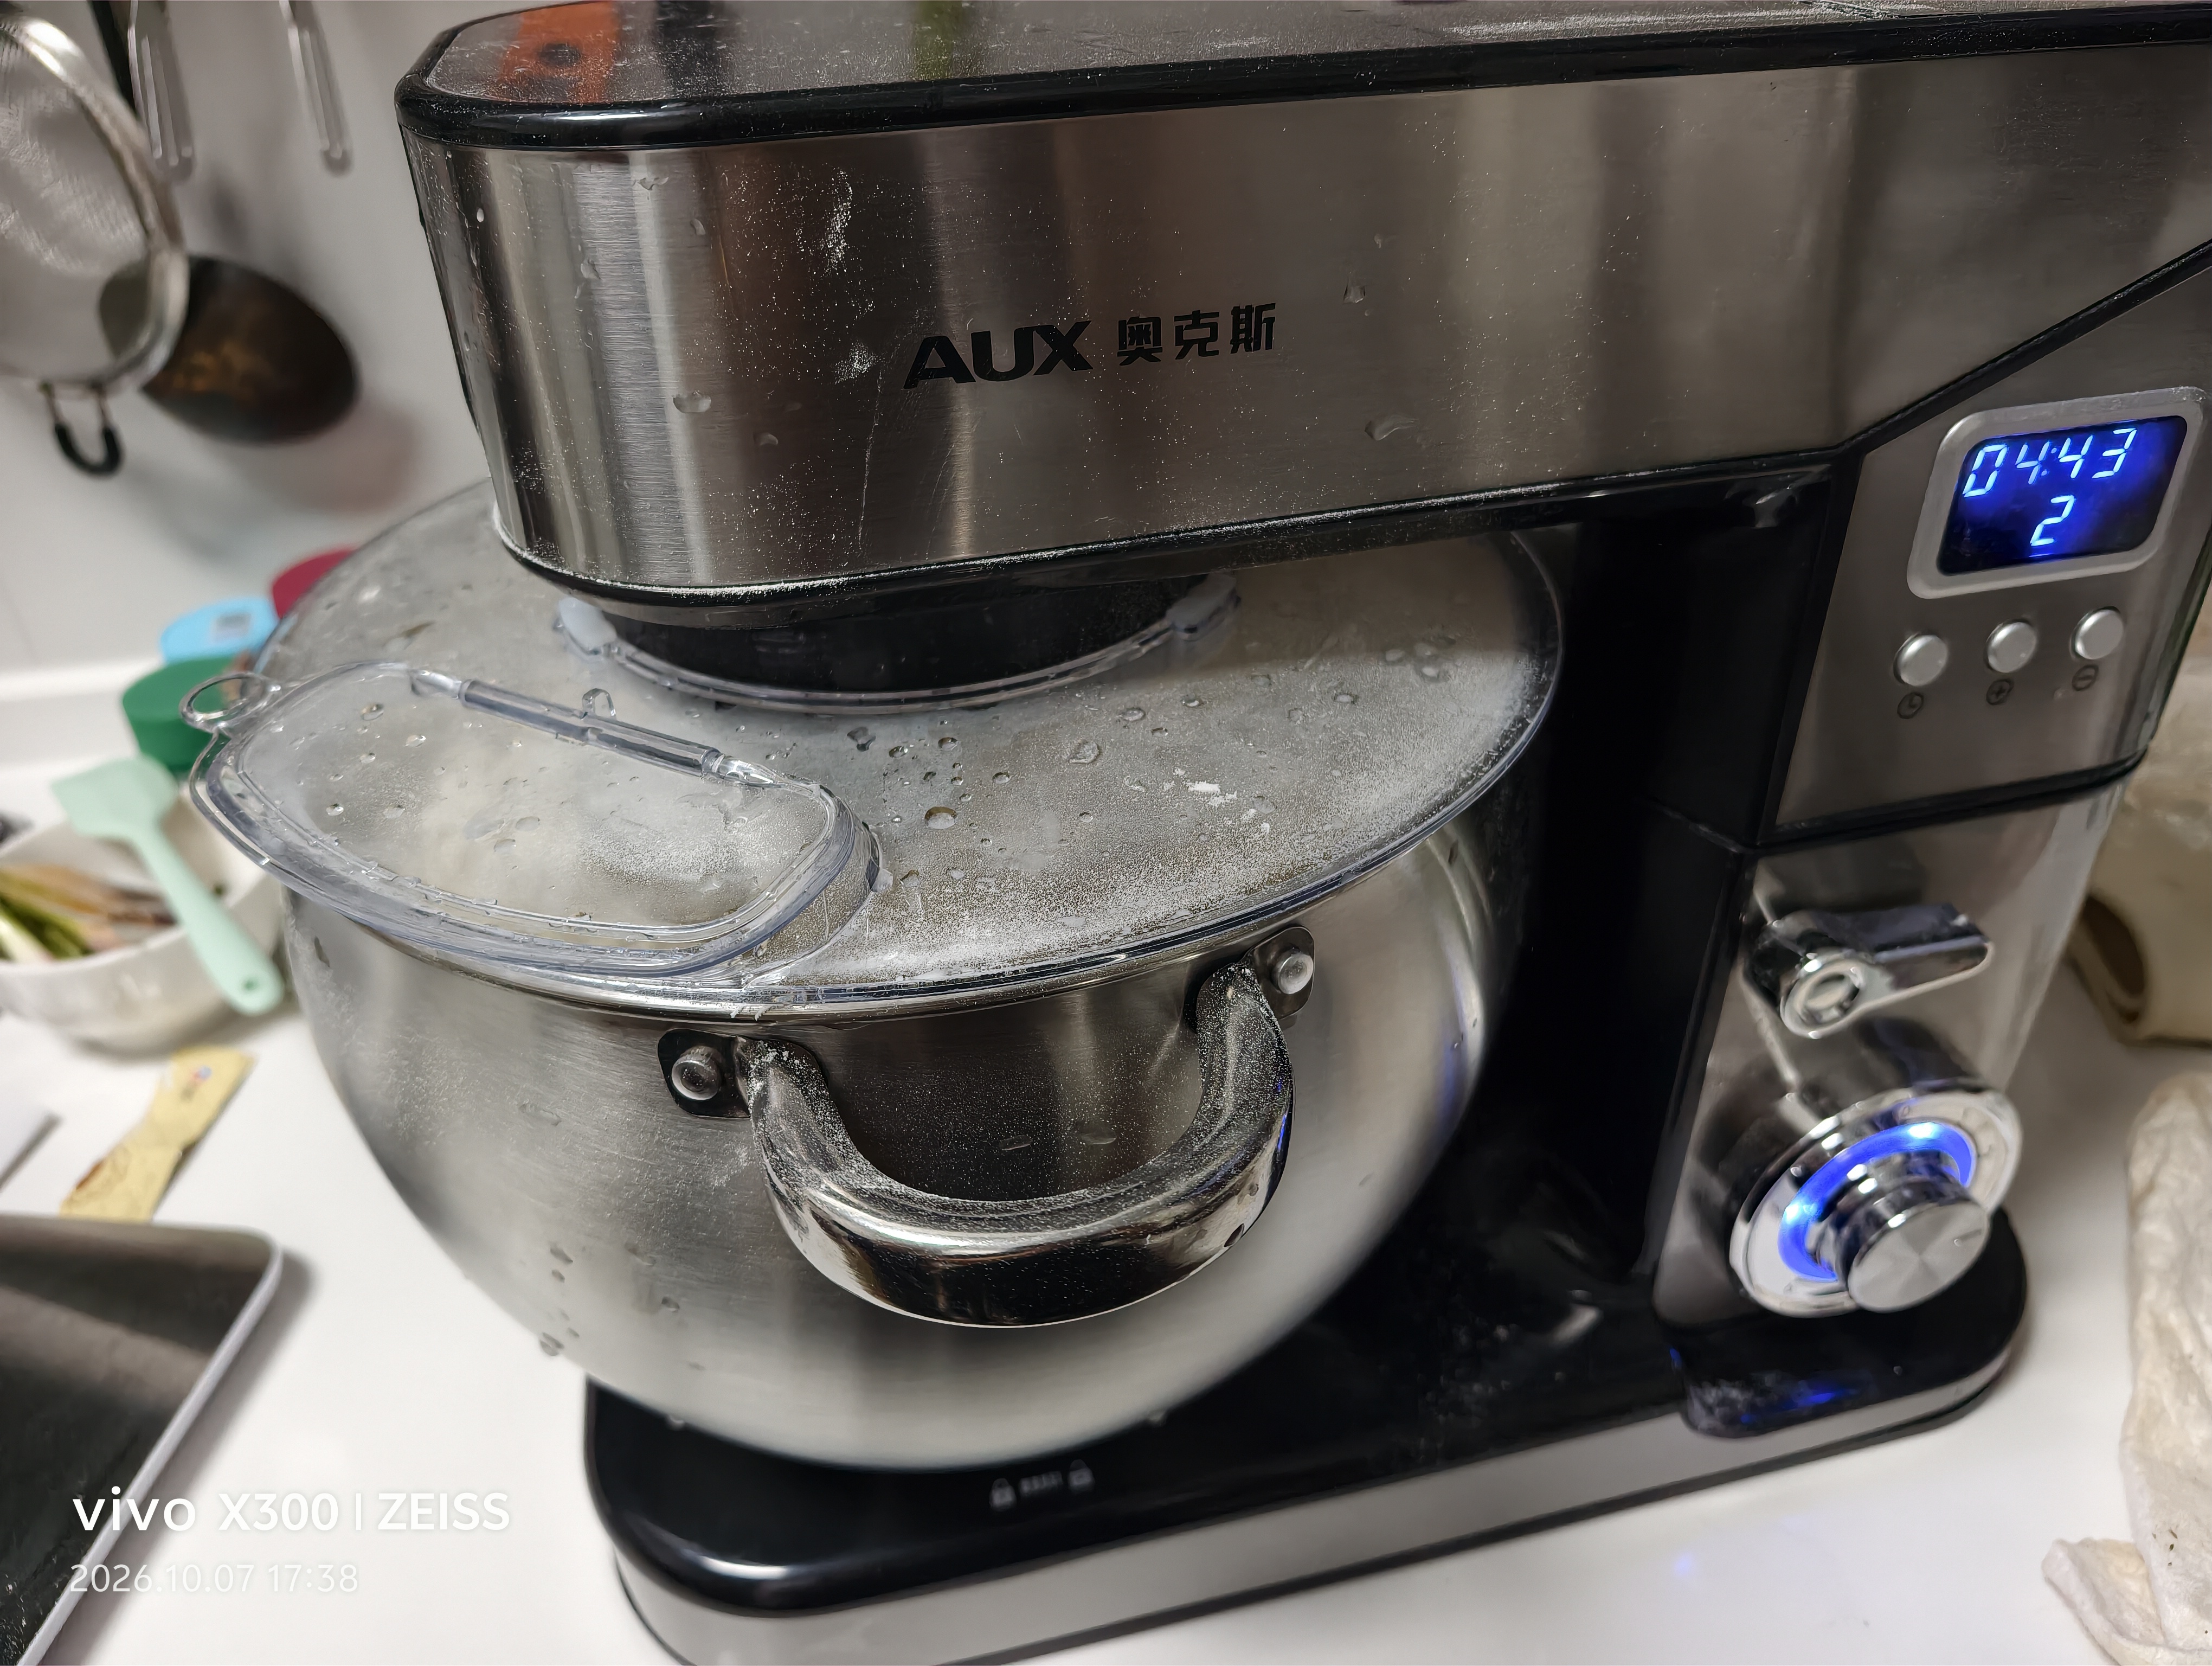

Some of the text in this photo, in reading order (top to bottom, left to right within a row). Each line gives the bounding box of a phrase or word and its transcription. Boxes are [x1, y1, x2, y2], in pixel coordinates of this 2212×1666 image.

[904, 303, 1276, 389] AUX 奥克斯
[1963, 428, 2137, 497] 04:43
[2030, 495, 2075, 546] 2
